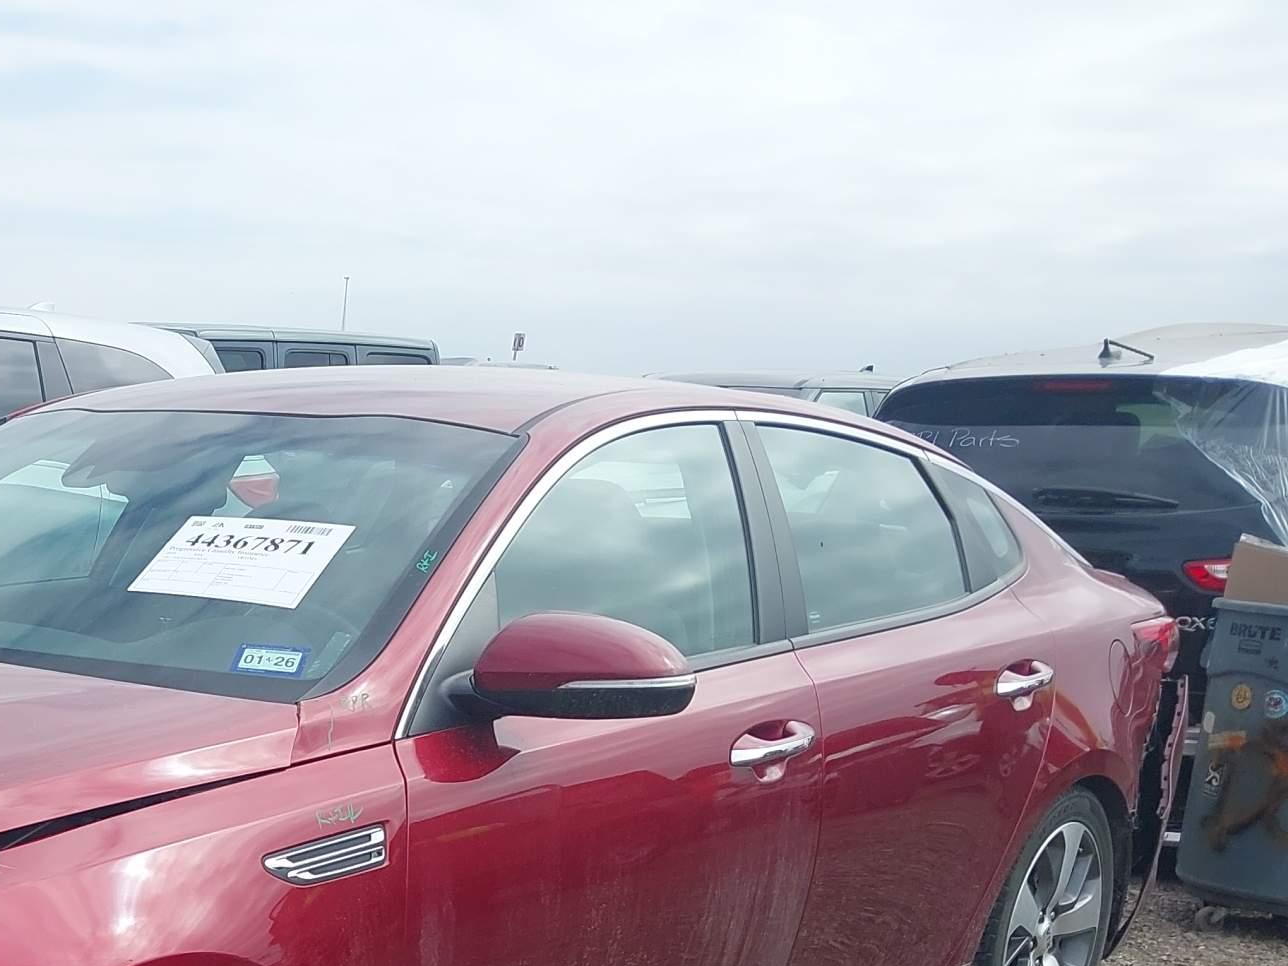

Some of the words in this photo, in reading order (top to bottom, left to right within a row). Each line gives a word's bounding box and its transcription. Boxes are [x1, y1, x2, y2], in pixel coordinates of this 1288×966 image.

[949, 427, 1021, 448] Parts
[185, 532, 316, 555] 44367871
[1230, 622, 1282, 641] BRUTE
